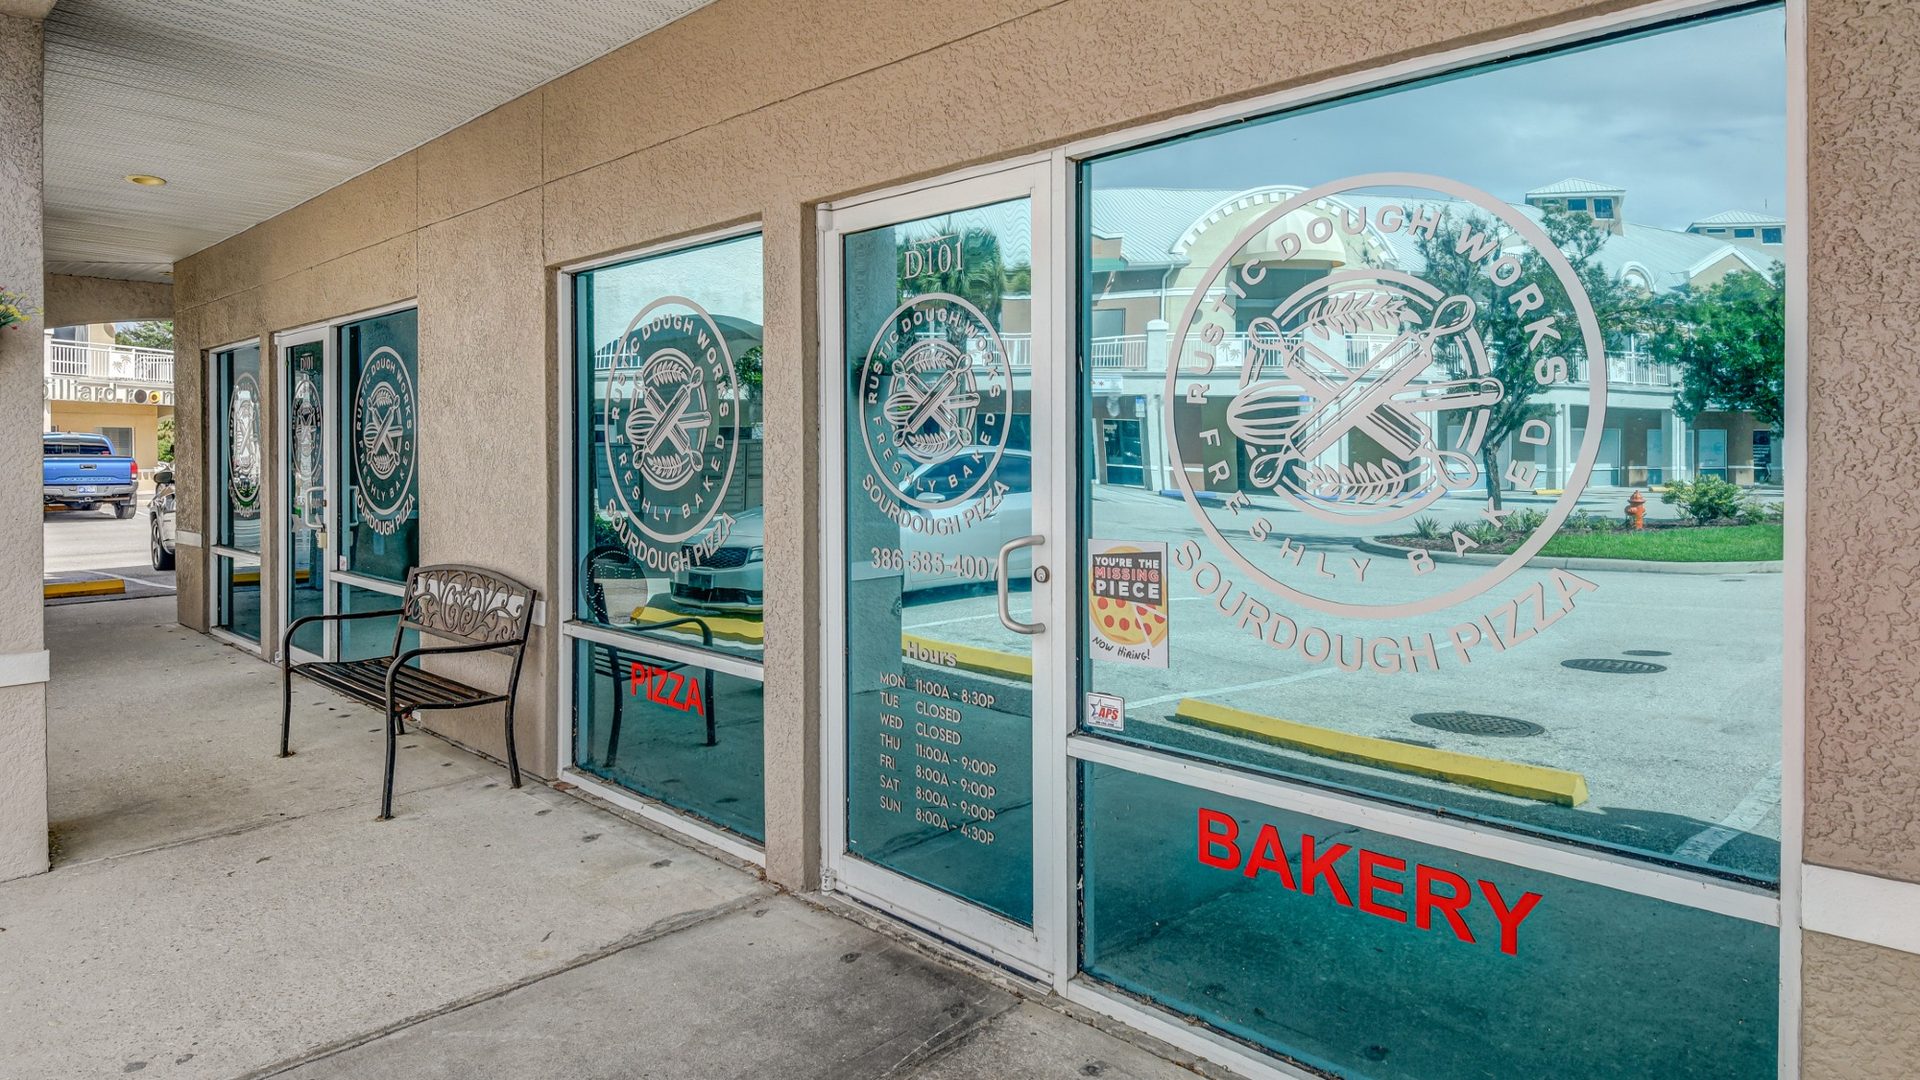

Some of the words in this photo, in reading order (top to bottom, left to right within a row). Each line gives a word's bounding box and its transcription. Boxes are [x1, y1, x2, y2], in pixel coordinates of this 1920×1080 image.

[904, 240, 965, 280] D101
[1186, 257, 1268, 404] RUSTIC
[1276, 204, 1442, 262] DOUGH
[1454, 223, 1568, 386] WORKS
[642, 313, 694, 340] DOUGH
[697, 329, 730, 417] WORKS
[868, 330, 899, 404] RUSTIC
[902, 307, 961, 333] DOUGH
[964, 320, 1002, 398] WORKS
[357, 373, 372, 431] RUSTIC
[371, 357, 396, 375] DOUGH
[396, 369, 413, 430] WORKS
[873, 415, 937, 492] FRESHLY
[948, 412, 996, 488] BAKED
[616, 434, 672, 523] FRESHLY
[682, 434, 725, 519] BAKED
[1198, 428, 1372, 583] FRESHLY
[1407, 418, 1552, 576] BAKED
[863, 474, 961, 536] SOURDOUGH
[963, 480, 1010, 528] PIZZA
[606, 498, 691, 572] SOURDOUGH
[693, 512, 738, 566] PIZZA
[1094, 556, 1132, 567] YOU'RE
[1138, 558, 1160, 569] THE
[1094, 567, 1160, 581] MISSING
[1095, 580, 1160, 599] PIECE
[1173, 538, 1440, 676] SOURDOUGH
[1448, 567, 1600, 664] PIZZA
[905, 640, 958, 668] Hours
[1092, 636, 1114, 652] NOW
[630, 661, 705, 716] PIZZA
[879, 671, 906, 689] MON
[915, 679, 950, 699] 11:00A
[961, 689, 995, 708] 8:30P
[880, 691, 900, 708] TUE
[915, 700, 962, 723] CLOSED
[880, 712, 904, 730] WED
[915, 722, 962, 745] CLOSED
[1098, 707, 1119, 721] APS
[880, 733, 901, 751] THU
[915, 743, 950, 765] 11:00A
[961, 756, 997, 777] 9:00P
[880, 754, 896, 770] FRI
[915, 764, 950, 787] 8:00A
[960, 778, 996, 799] 9:00P
[880, 775, 901, 792] SAT
[915, 786, 950, 808] 8:00A
[960, 800, 996, 822] 9:00P
[880, 795, 903, 814] SUN
[915, 808, 950, 831] 8:00A
[960, 822, 995, 845] 4:30P
[1197, 806, 1543, 957] BAKERY
